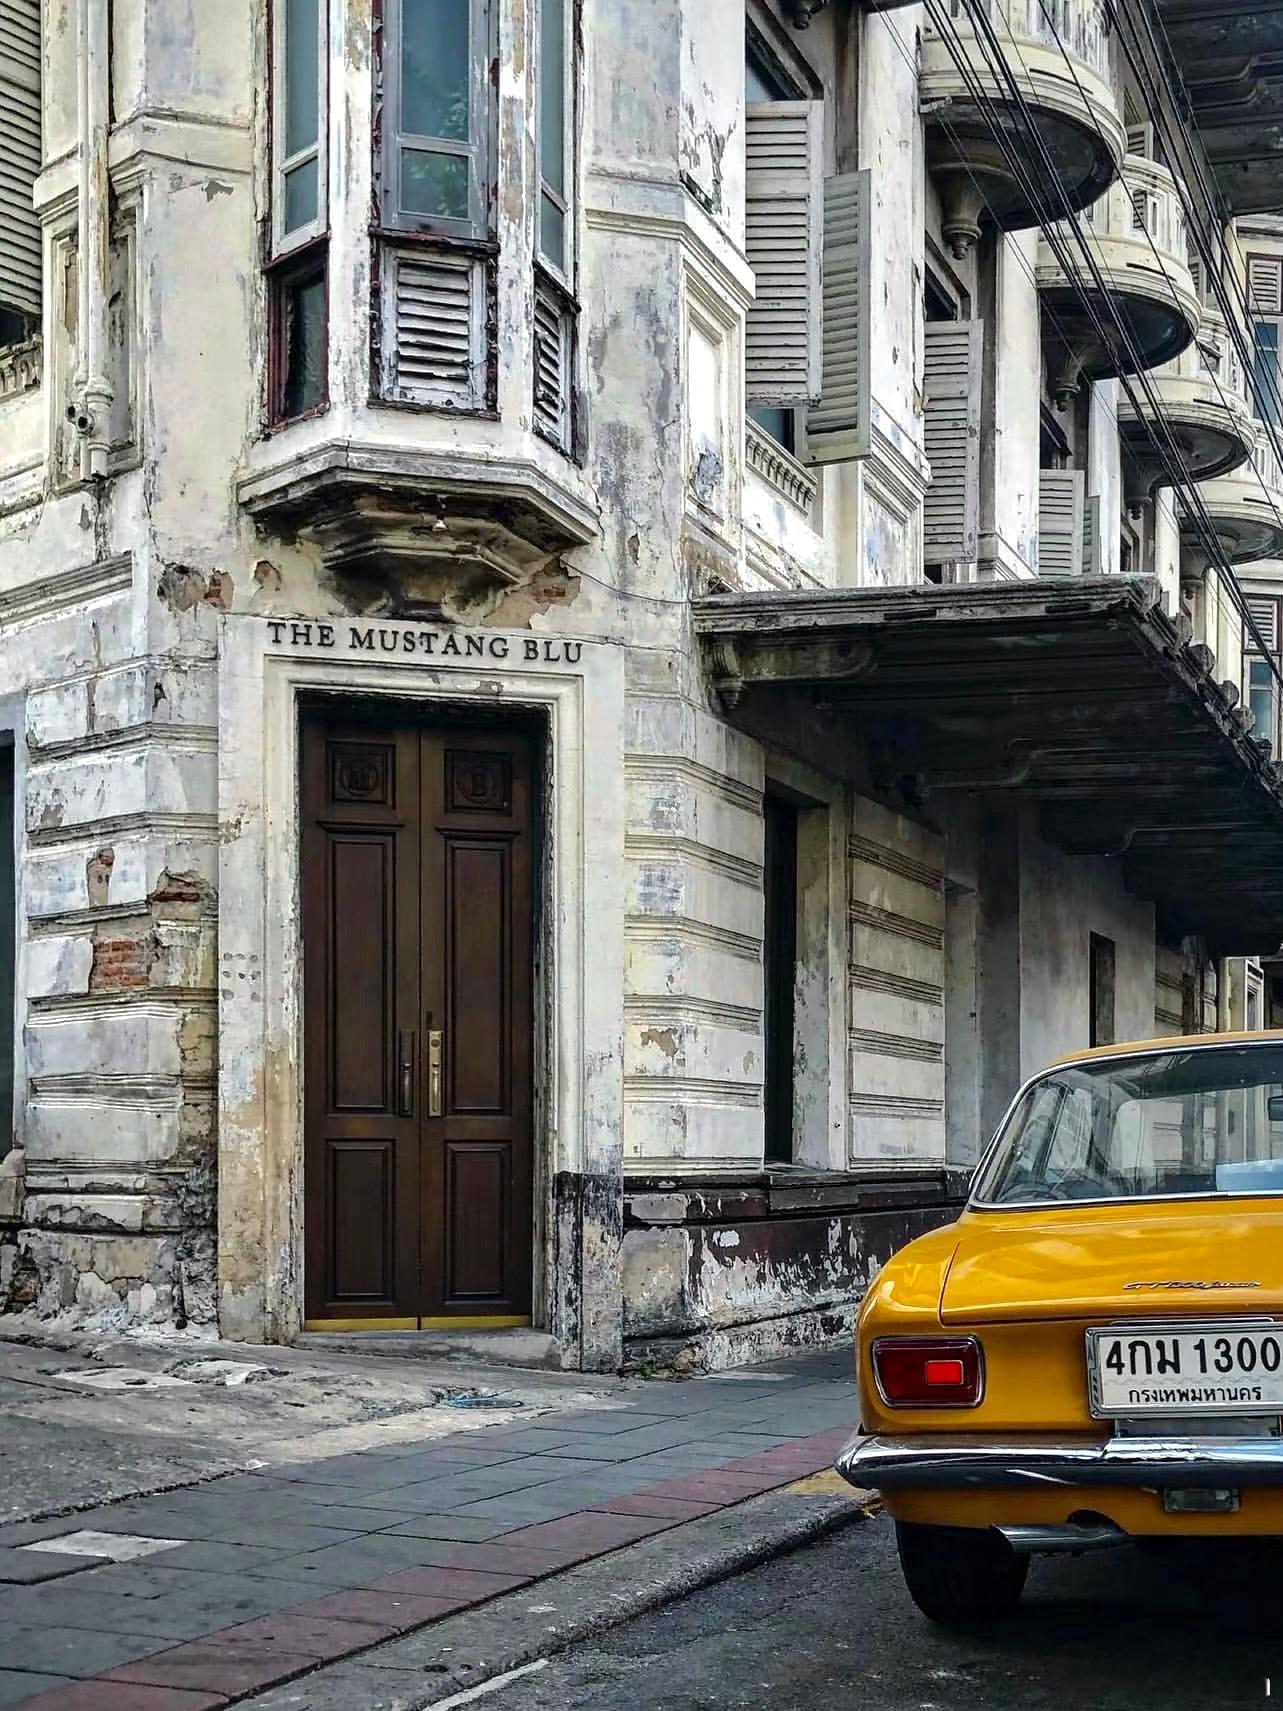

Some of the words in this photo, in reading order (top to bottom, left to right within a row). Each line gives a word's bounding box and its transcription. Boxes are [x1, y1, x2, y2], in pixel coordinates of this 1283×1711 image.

[267, 621, 335, 648] THE
[349, 627, 509, 659] MUSTANG
[523, 640, 584, 664] BLU
[1106, 1340, 1181, 1376] 4กม
[1193, 1336, 1281, 1375] 1300
